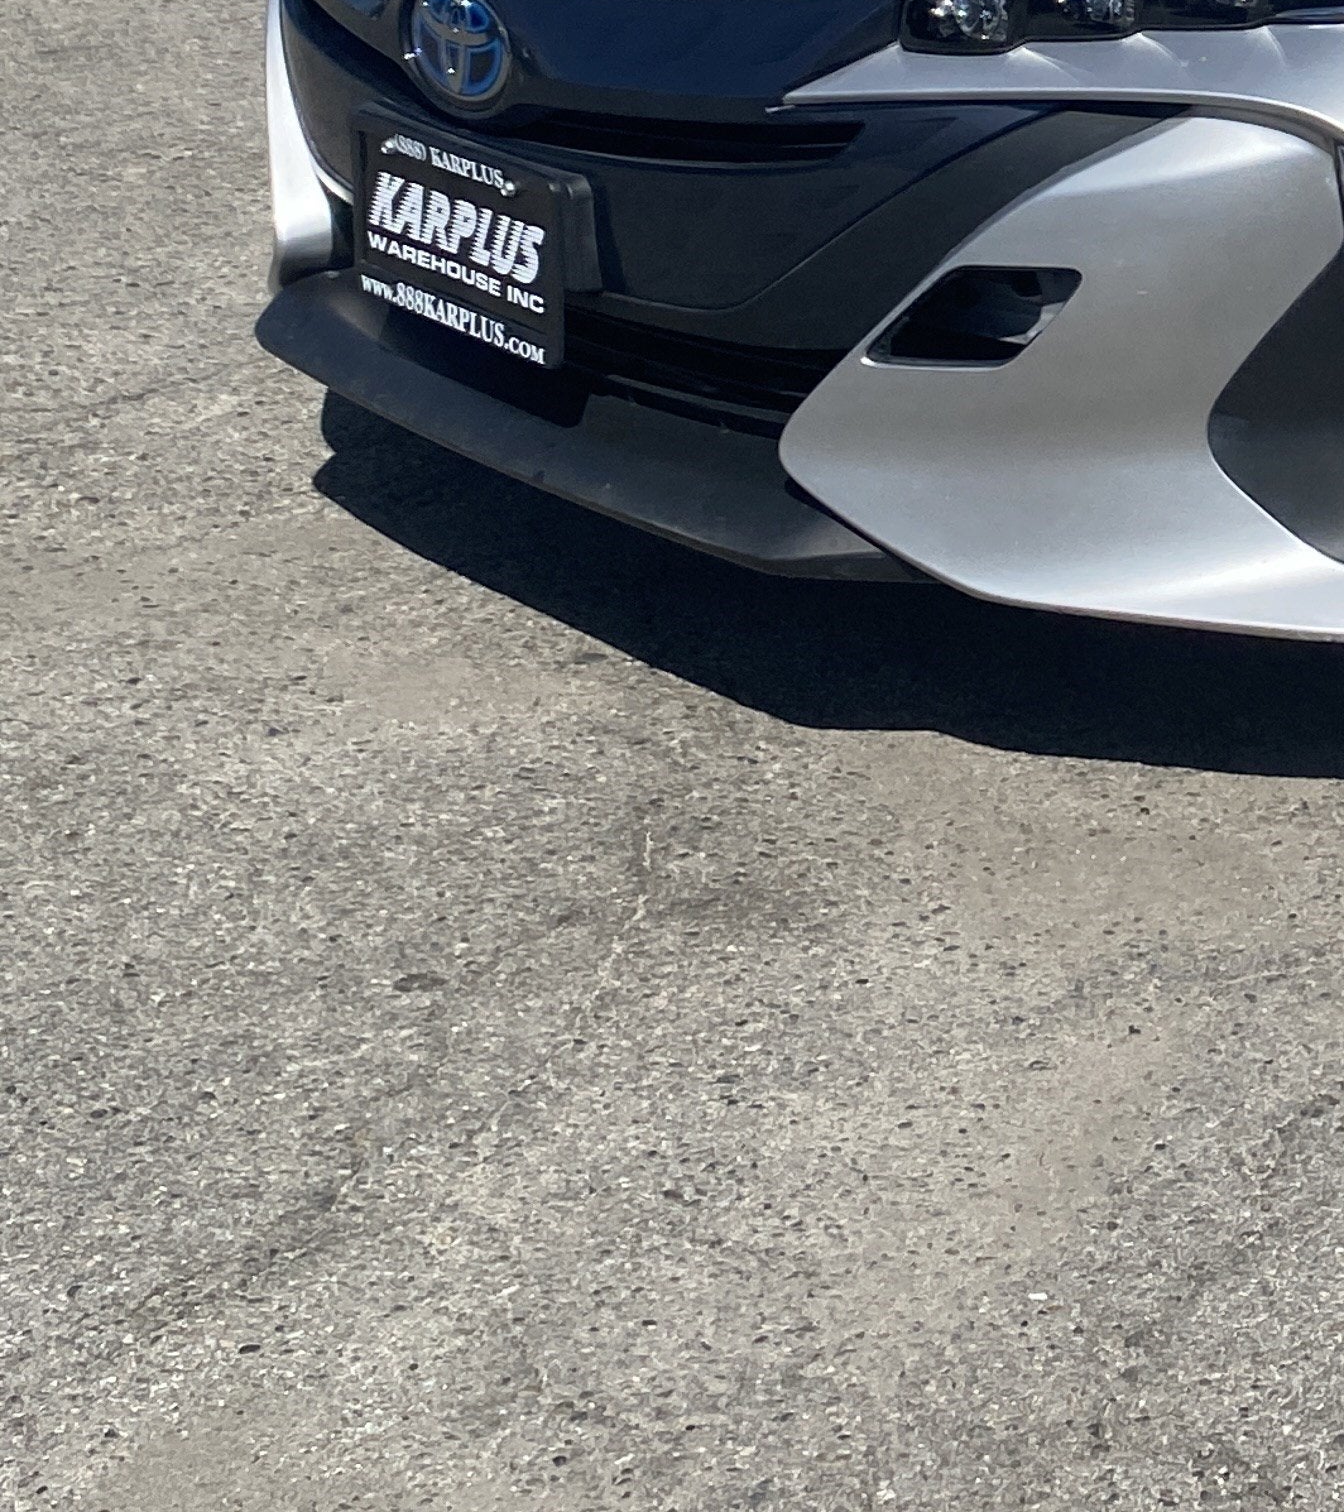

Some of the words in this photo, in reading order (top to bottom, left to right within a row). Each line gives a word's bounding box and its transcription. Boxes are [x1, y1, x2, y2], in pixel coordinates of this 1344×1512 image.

[430, 146, 506, 189] KARPLUS
[366, 171, 546, 285] KARPLUS
[367, 230, 502, 296] WAREHOUSE
[507, 283, 545, 314] INC
